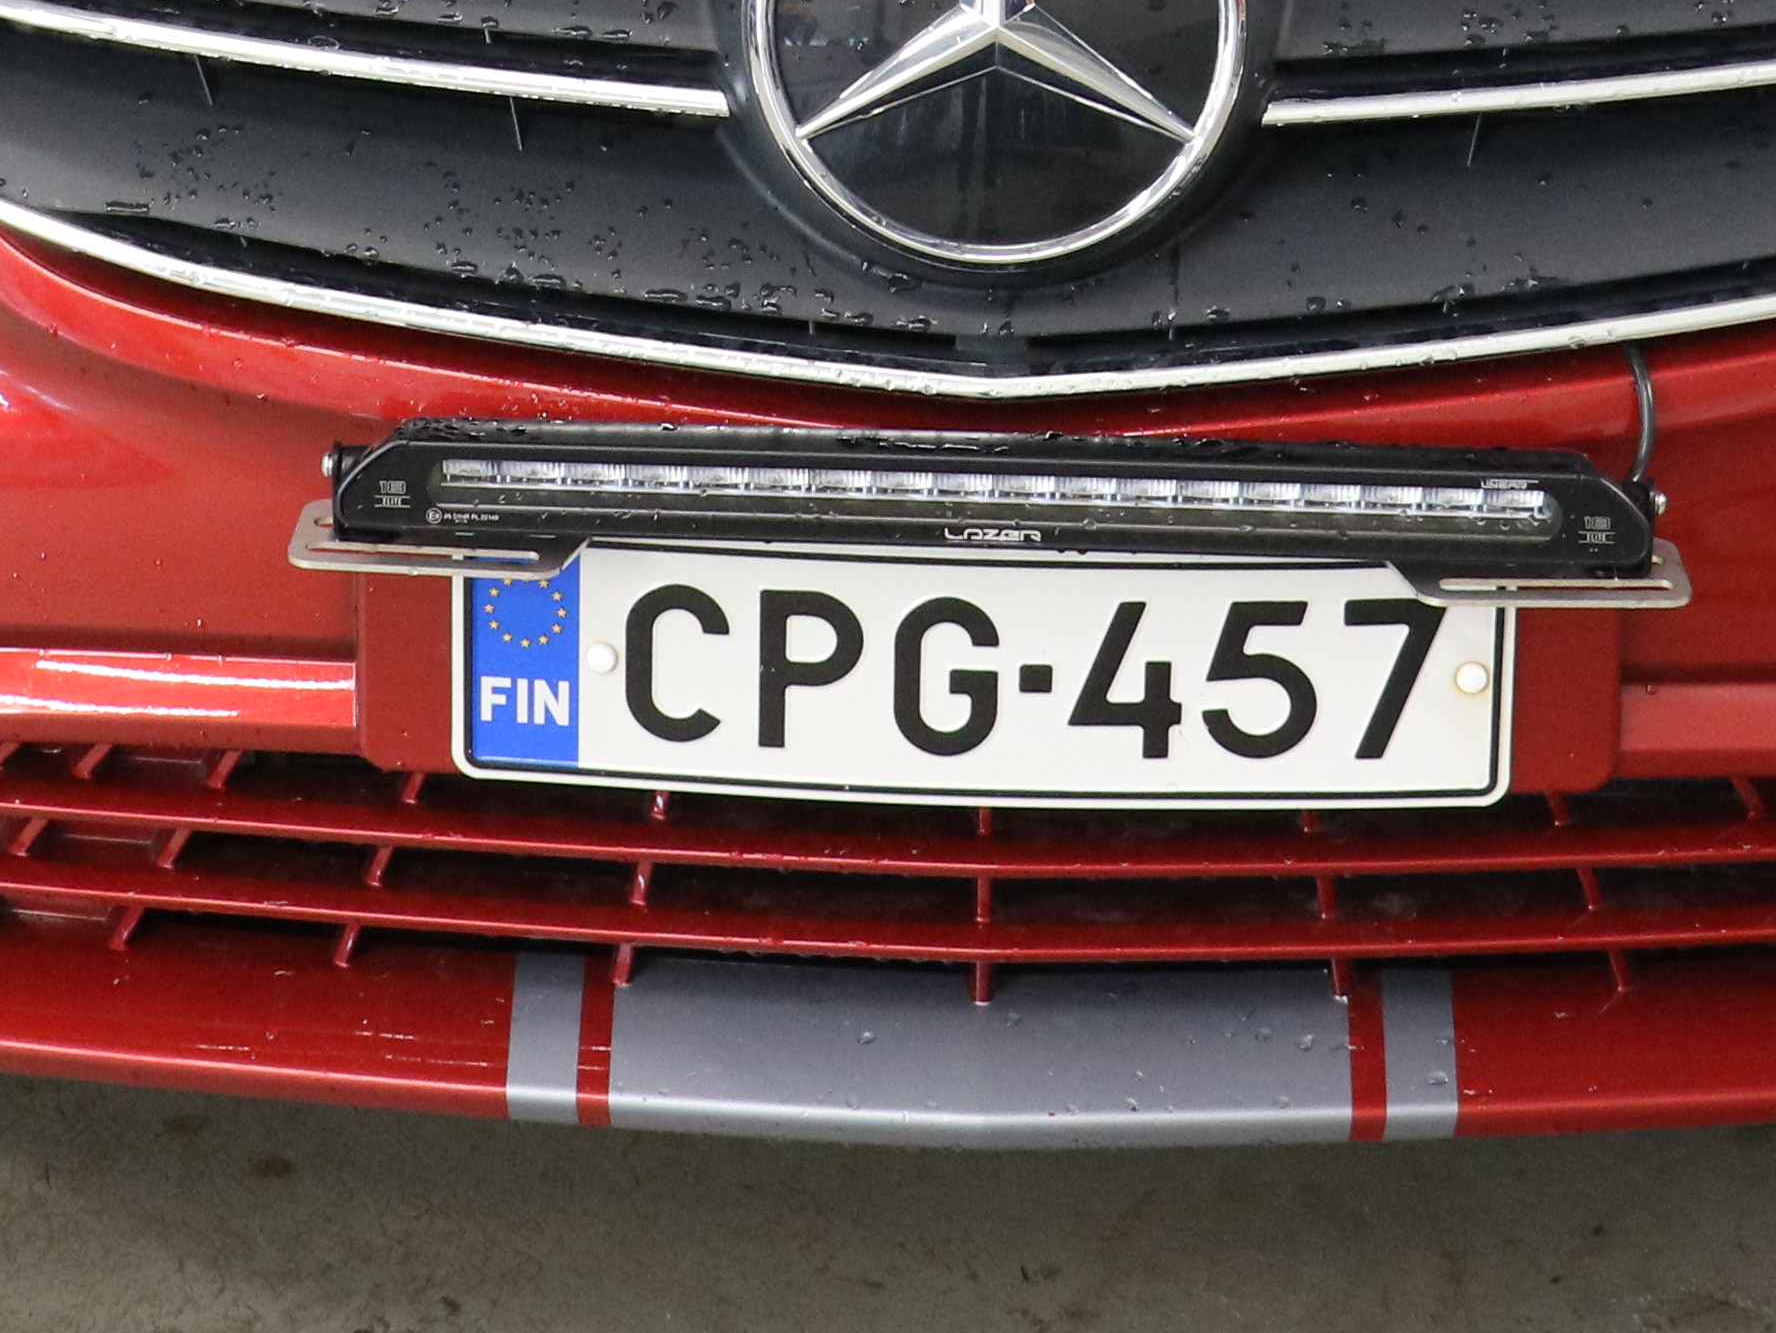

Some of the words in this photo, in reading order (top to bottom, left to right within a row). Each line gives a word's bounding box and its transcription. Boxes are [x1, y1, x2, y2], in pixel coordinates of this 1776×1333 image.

[944, 527, 1042, 542] LAZER
[626, 585, 1447, 759] CPG-457
[480, 675, 571, 726] FIN
